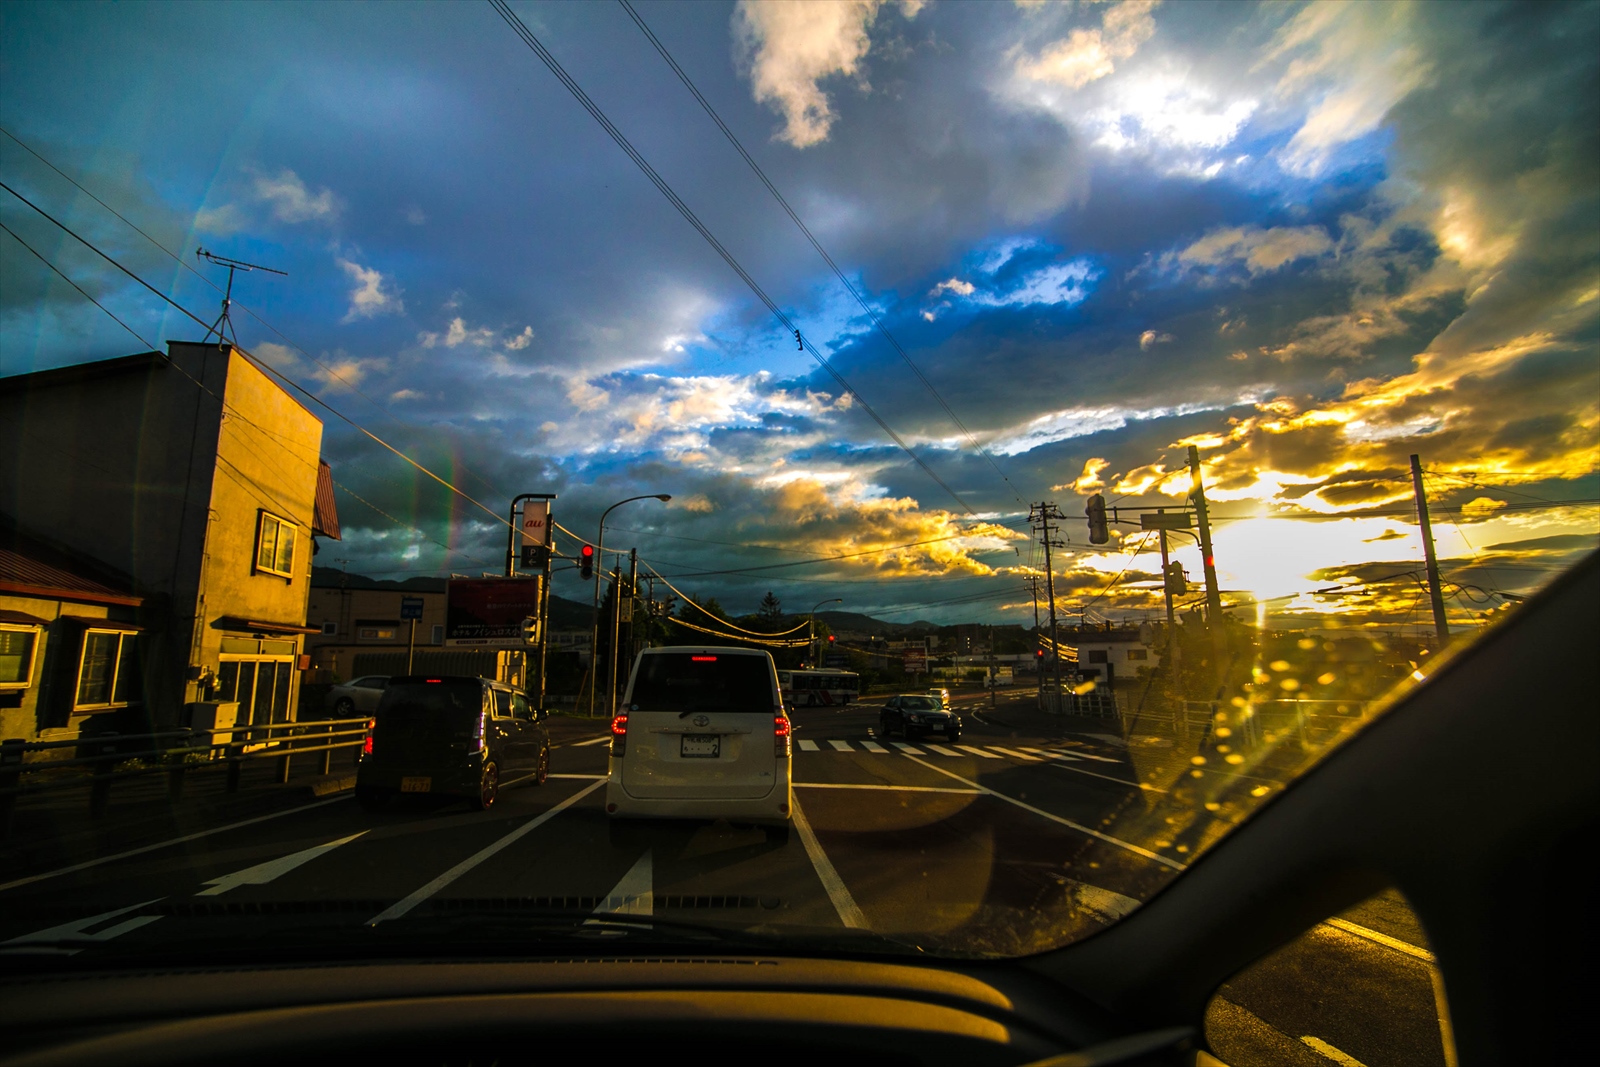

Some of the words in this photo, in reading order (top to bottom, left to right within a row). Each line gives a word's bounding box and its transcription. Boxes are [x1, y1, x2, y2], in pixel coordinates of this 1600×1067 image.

[525, 520, 545, 528] au
[530, 548, 536, 556] P
[472, 627, 520, 637] ノイシュロス小
